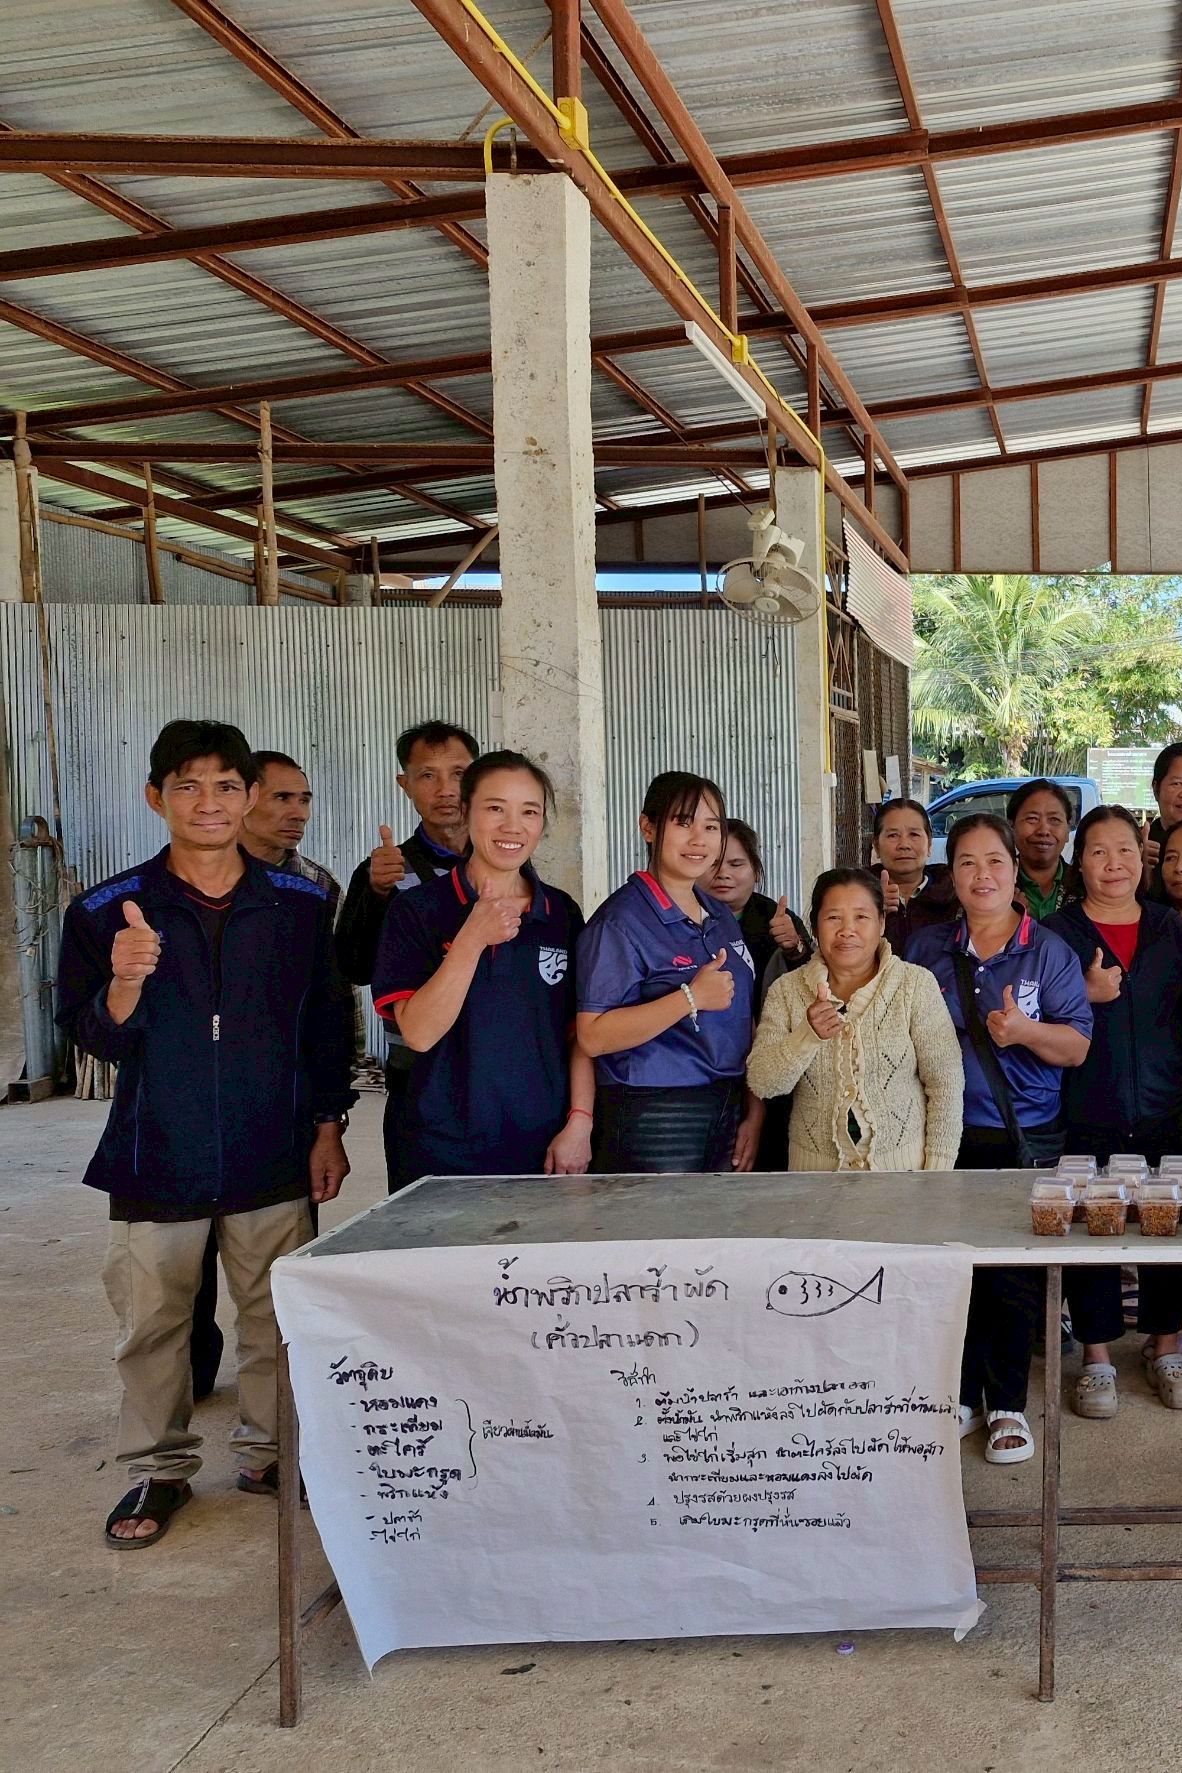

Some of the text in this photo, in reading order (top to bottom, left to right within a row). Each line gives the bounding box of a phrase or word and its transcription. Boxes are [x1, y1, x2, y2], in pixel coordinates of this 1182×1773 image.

[360, 1395, 437, 1412] หอมแดง
[363, 1414, 442, 1435] กระเทียม
[367, 1435, 433, 1457] ตะไคร้
[369, 1462, 461, 1486] ใบมะกรูด
